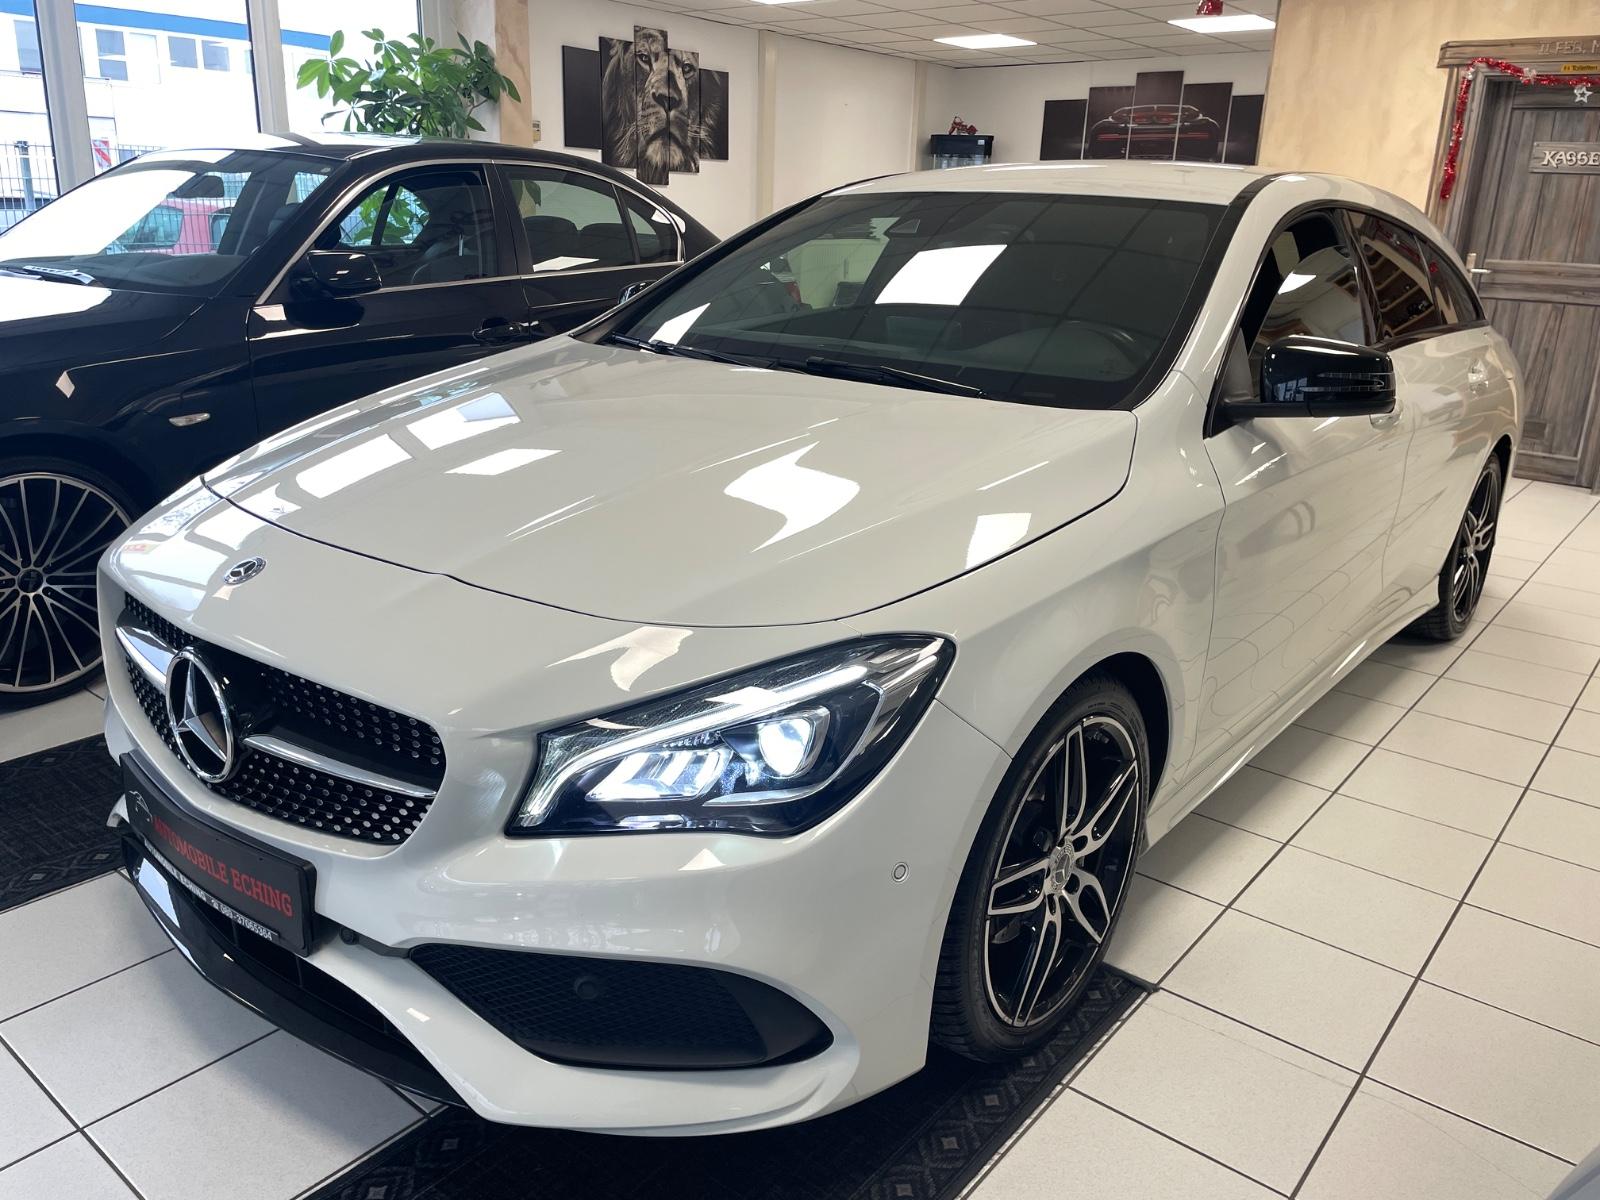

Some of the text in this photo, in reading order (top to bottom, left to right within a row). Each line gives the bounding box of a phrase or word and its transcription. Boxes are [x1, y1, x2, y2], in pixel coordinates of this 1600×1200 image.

[1541, 150, 1600, 168] KASSE
[153, 815, 229, 885] AUTOMOBILE
[230, 867, 293, 917] ECHING
